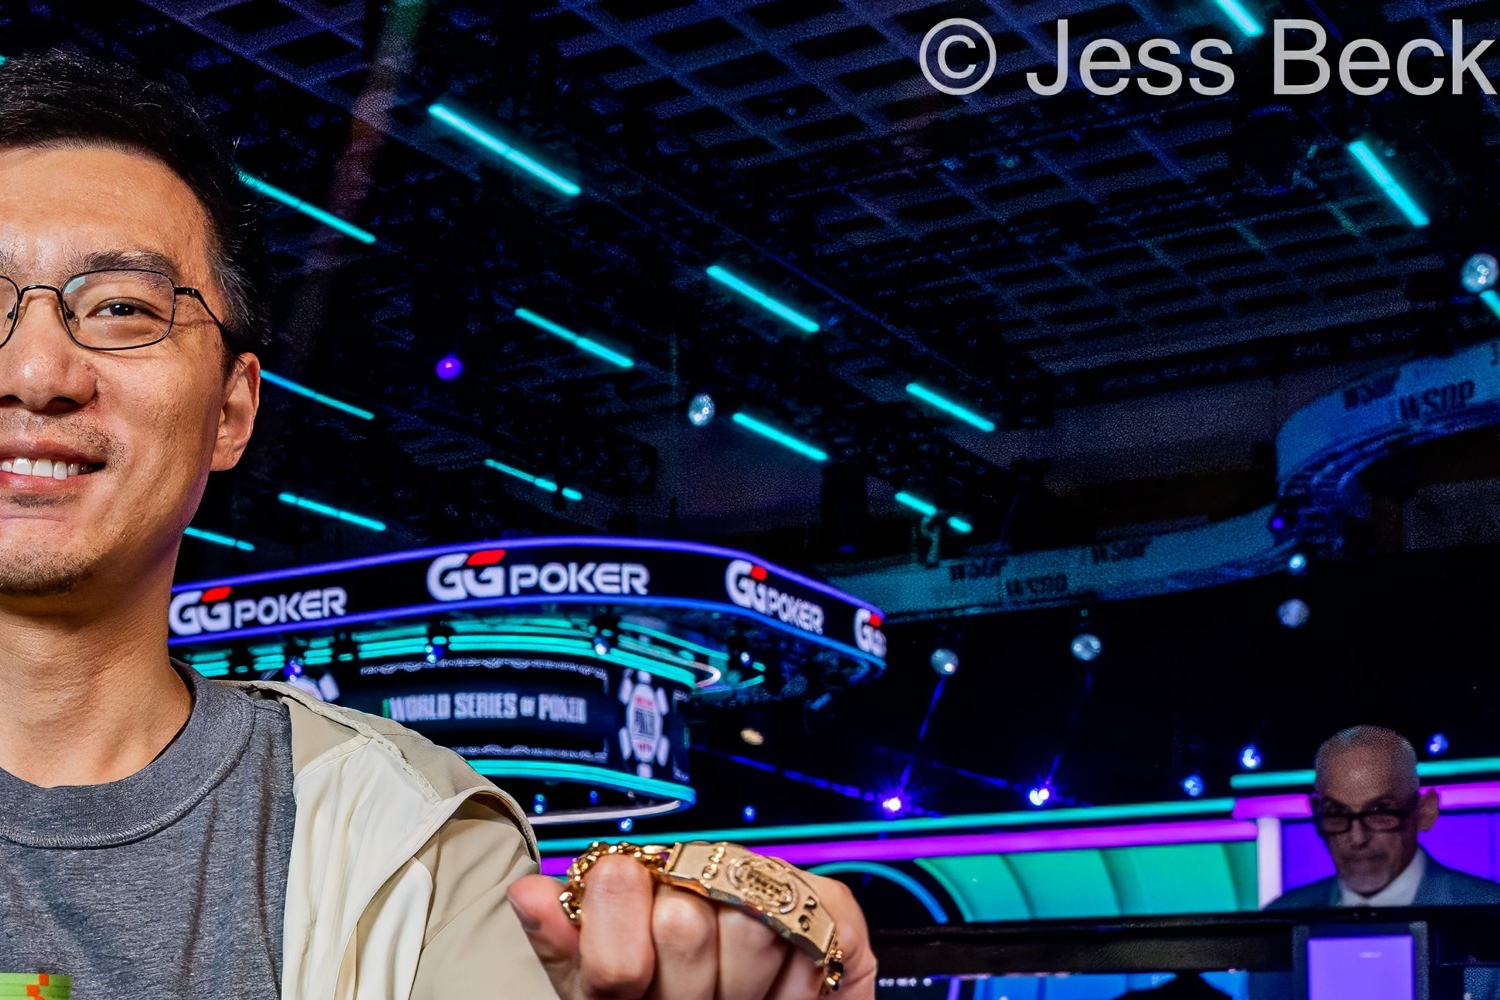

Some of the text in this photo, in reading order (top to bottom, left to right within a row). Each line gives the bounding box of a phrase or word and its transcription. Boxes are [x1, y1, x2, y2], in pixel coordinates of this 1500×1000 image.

[390, 693, 451, 723] WORLD
[454, 692, 518, 720] SERIES
[538, 694, 588, 724] POKER
